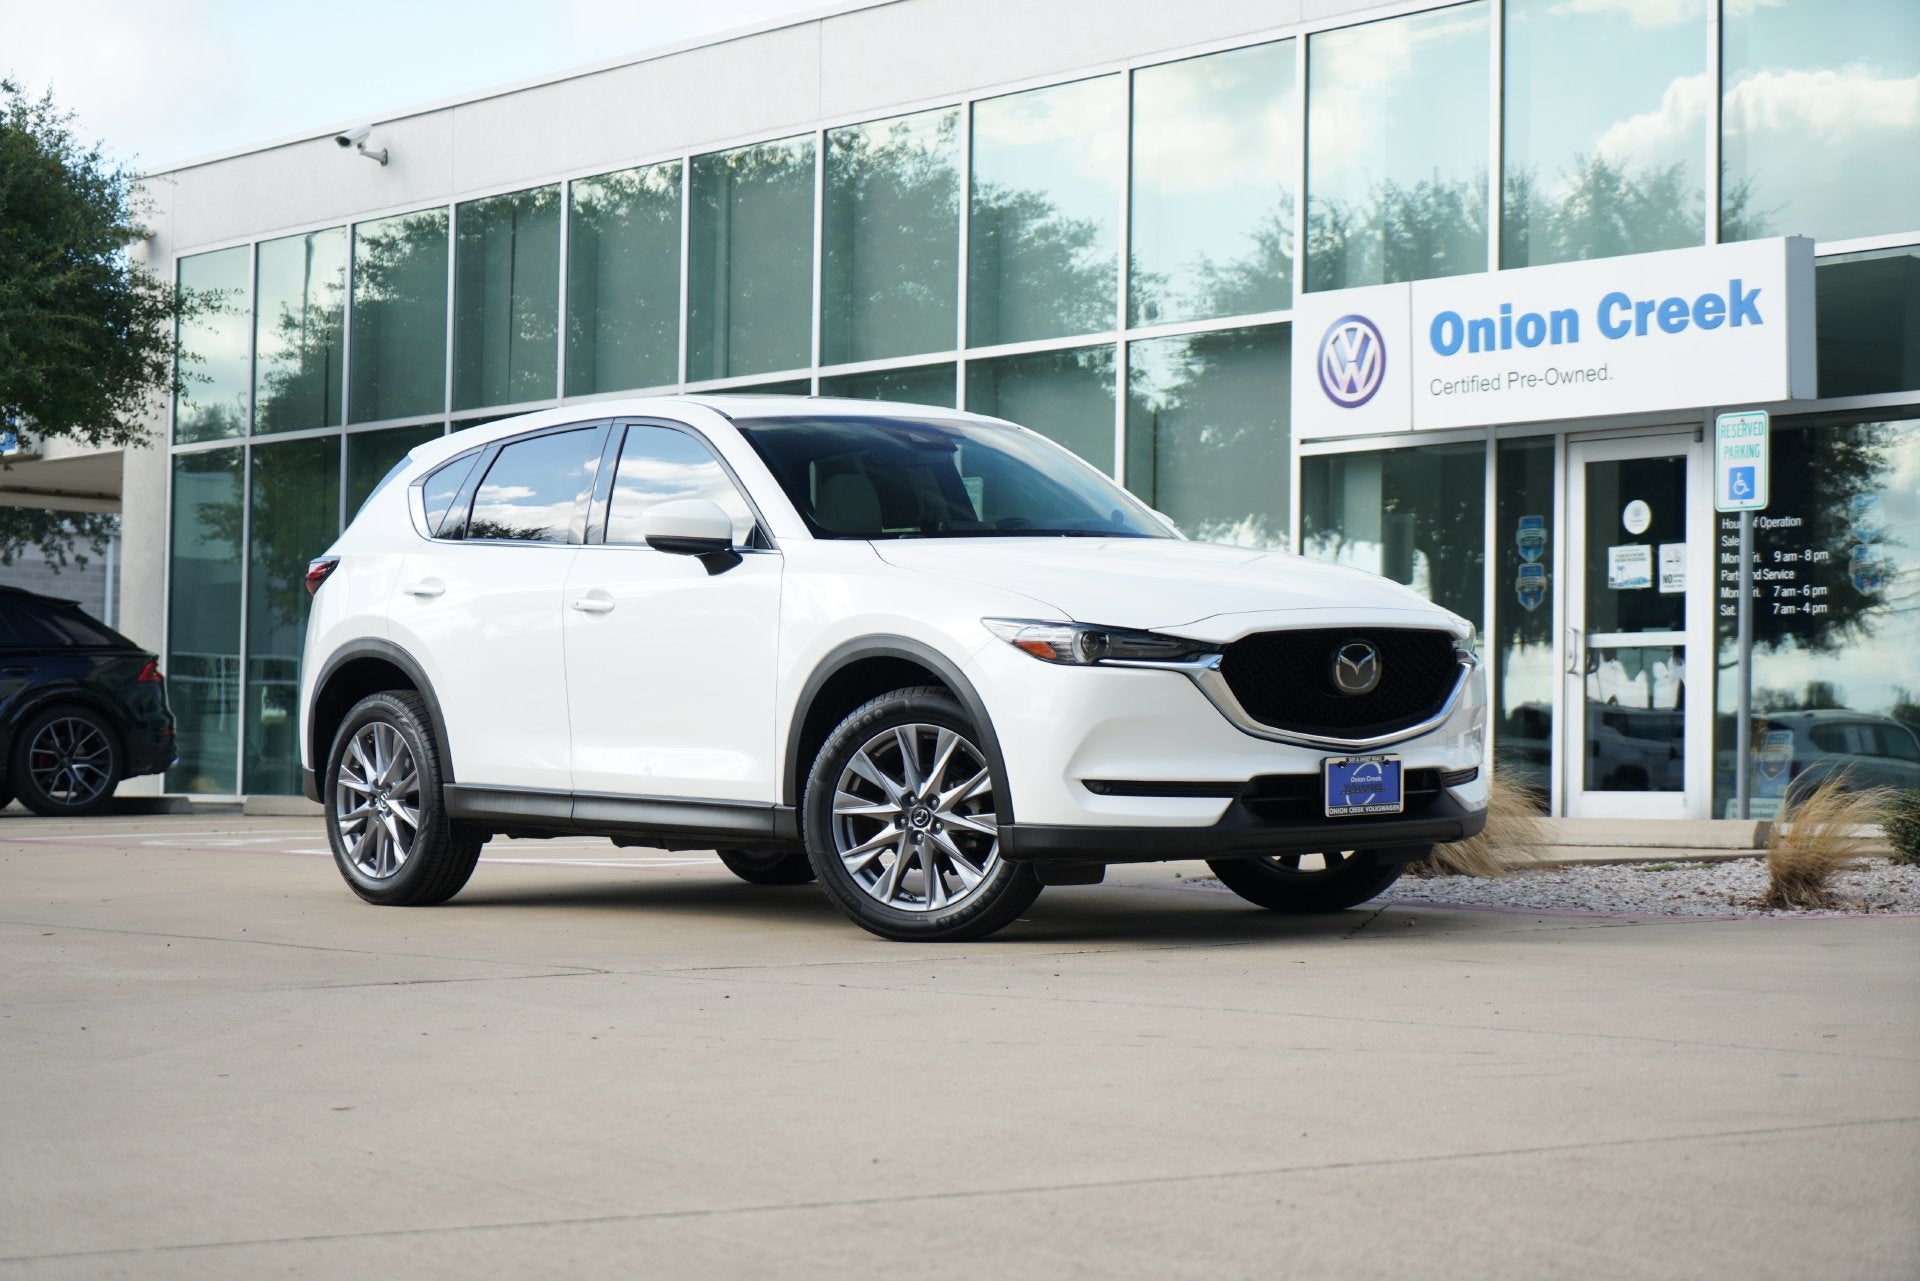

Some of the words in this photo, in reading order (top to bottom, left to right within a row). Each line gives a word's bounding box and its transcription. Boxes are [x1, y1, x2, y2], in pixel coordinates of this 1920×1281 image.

[1429, 303, 1579, 357] Onion
[1596, 278, 1764, 340] Creek
[1430, 371, 1501, 397] Certified
[1507, 363, 1613, 391] Pre-Owned.
[1721, 421, 1764, 438] RESERVED
[1724, 443, 1760, 460] PARKING
[1760, 517, 1801, 529] Operation
[1721, 535, 1740, 547] Sale
[1774, 550, 1781, 563] 9
[1782, 552, 1797, 562] am
[1804, 549, 1812, 561] 8
[1813, 551, 1829, 562] pm
[1662, 574, 1673, 584] NO
[1721, 570, 1740, 581] Part
[1763, 569, 1794, 579] Service
[1773, 585, 1781, 597] 7
[1781, 587, 1796, 597] am
[1803, 584, 1810, 597] 6
[1812, 586, 1828, 598] pm
[1720, 603, 1737, 616] Sat.
[1773, 602, 1781, 614] 7
[1781, 604, 1796, 614] am
[1802, 601, 1810, 614] 4
[1812, 603, 1828, 615] pm
[1329, 806, 1348, 815] ONION
[1349, 805, 1365, 813] CREEK
[1365, 804, 1400, 813] VOLKSWAGEN
